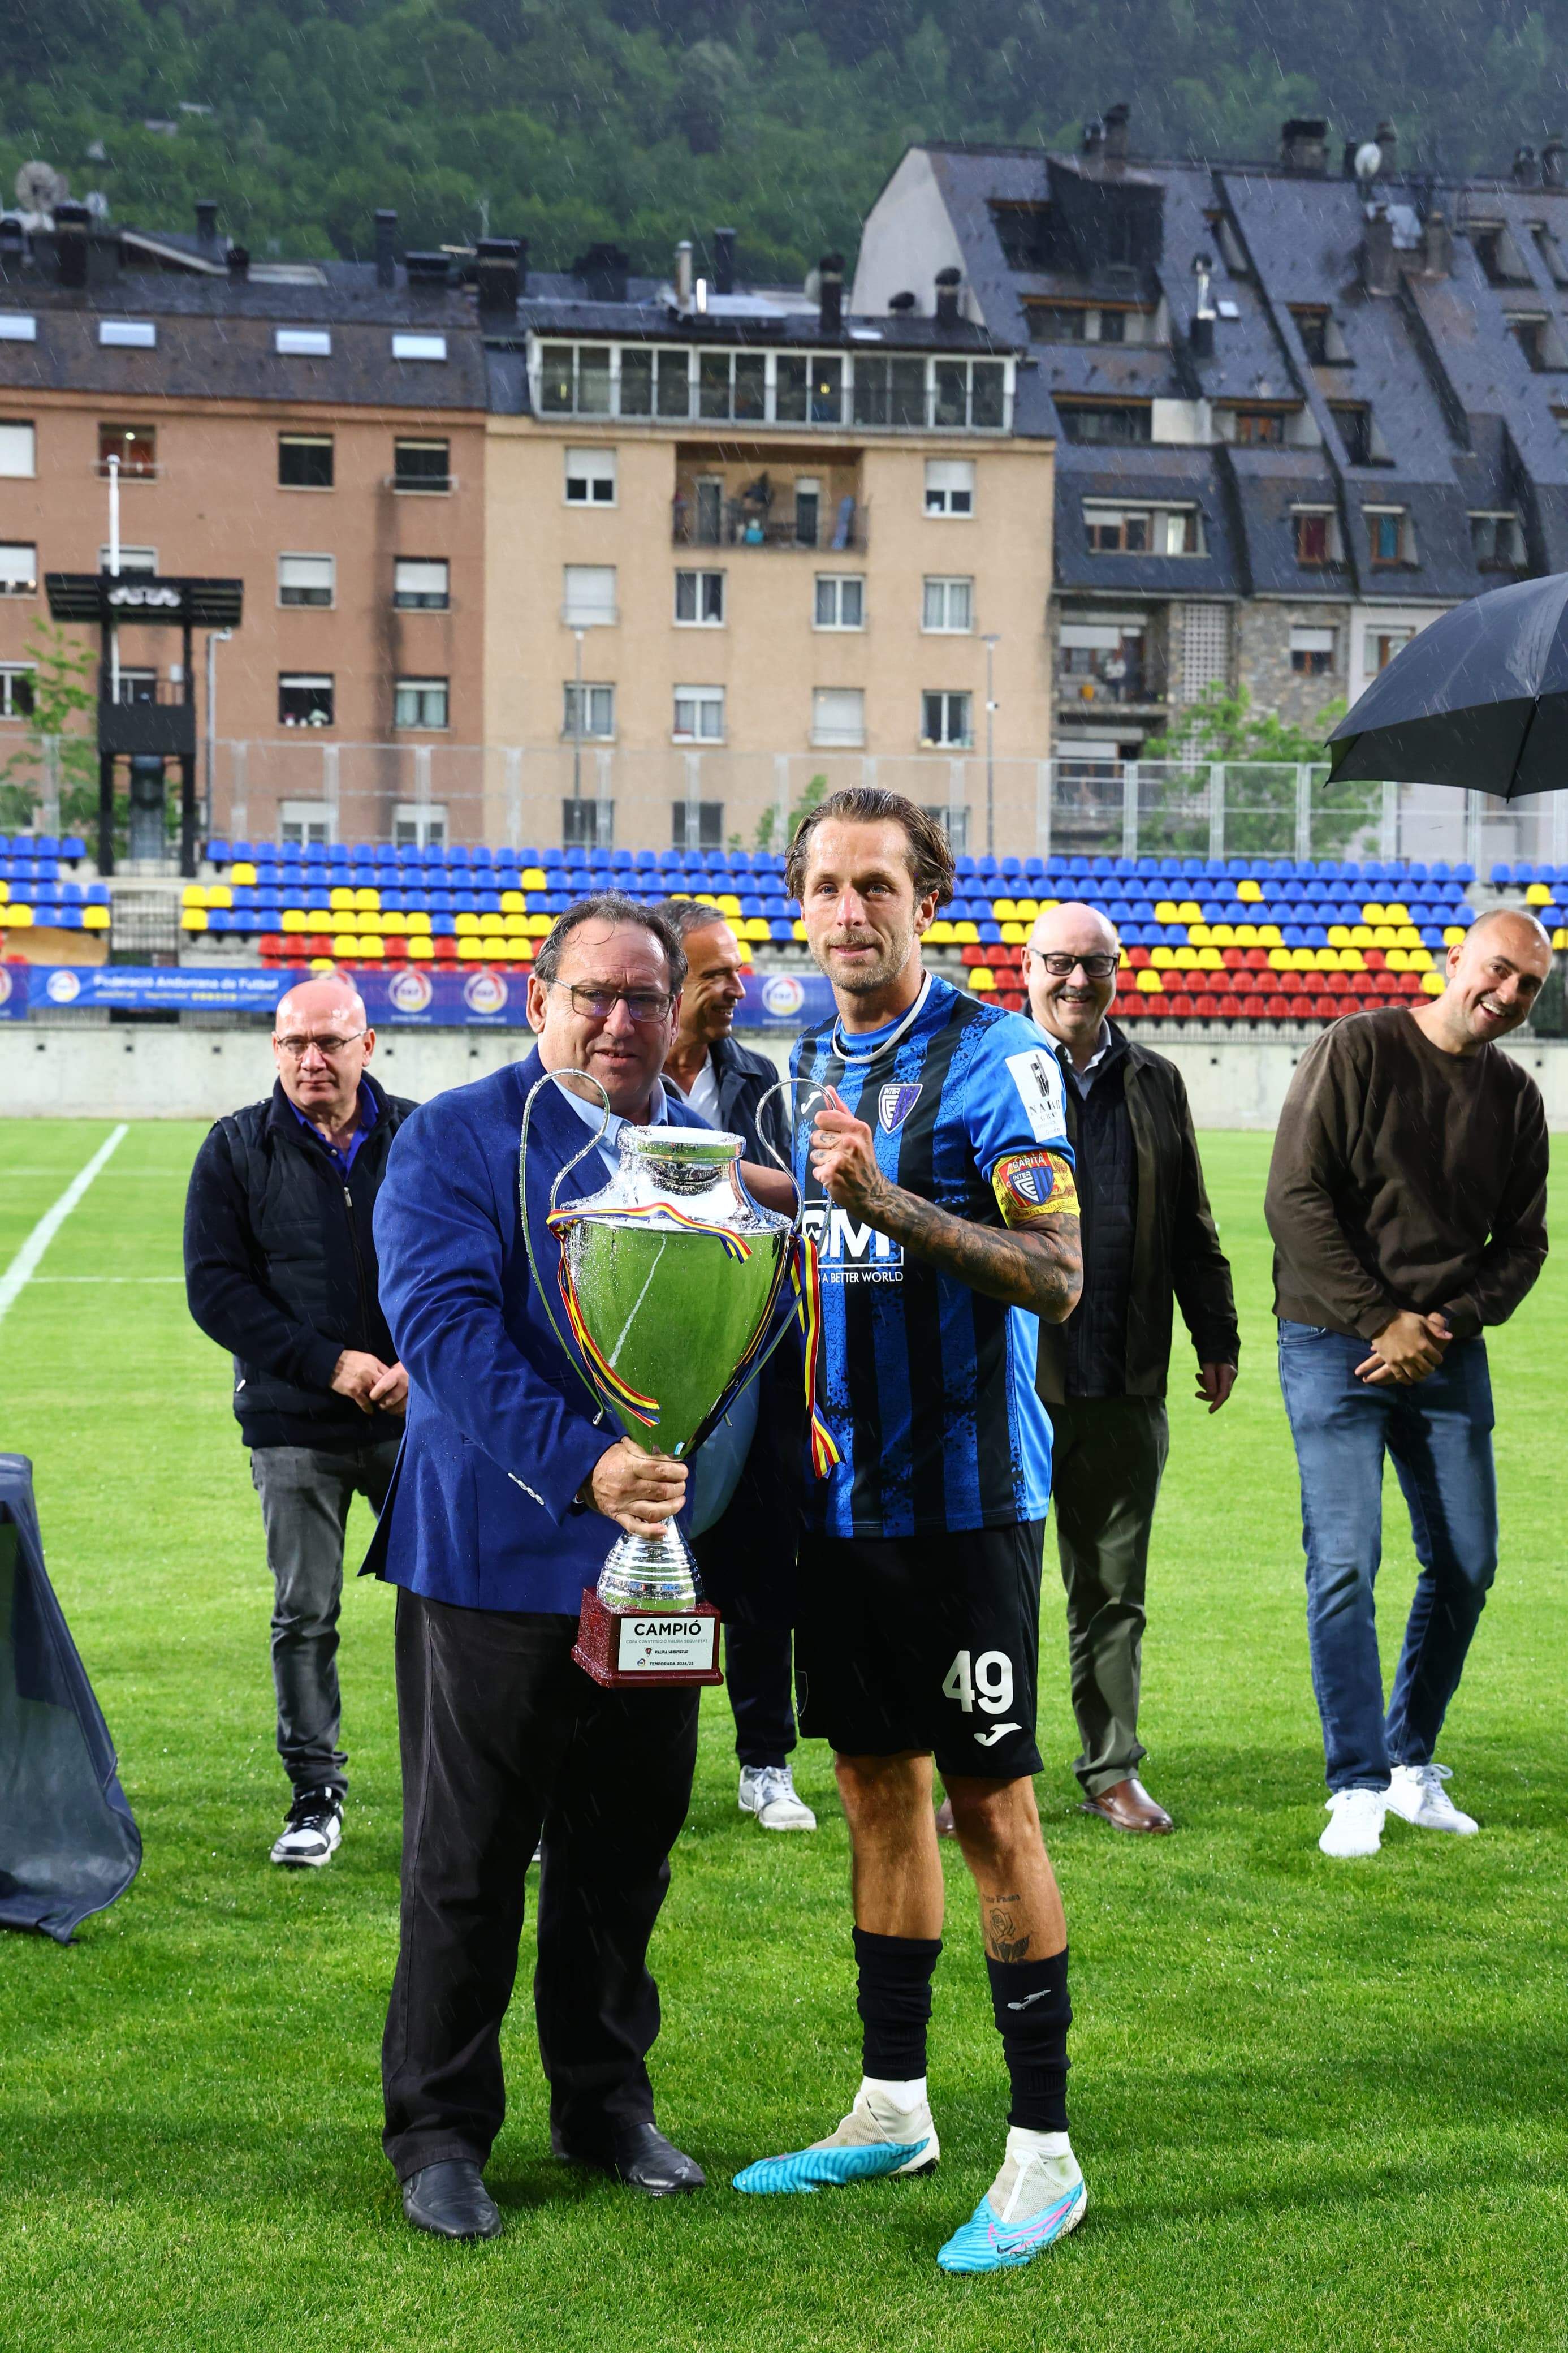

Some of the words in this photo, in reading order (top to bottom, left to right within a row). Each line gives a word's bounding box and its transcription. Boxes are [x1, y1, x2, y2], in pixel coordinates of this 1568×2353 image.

[1013, 1171, 1032, 1182] INTER
[822, 1273, 828, 1283] A
[831, 1272, 859, 1283] BETTER
[862, 1271, 904, 1283] WORLD
[634, 1619, 701, 1636] CAMPIÓ
[941, 1650, 1014, 1714] 49
